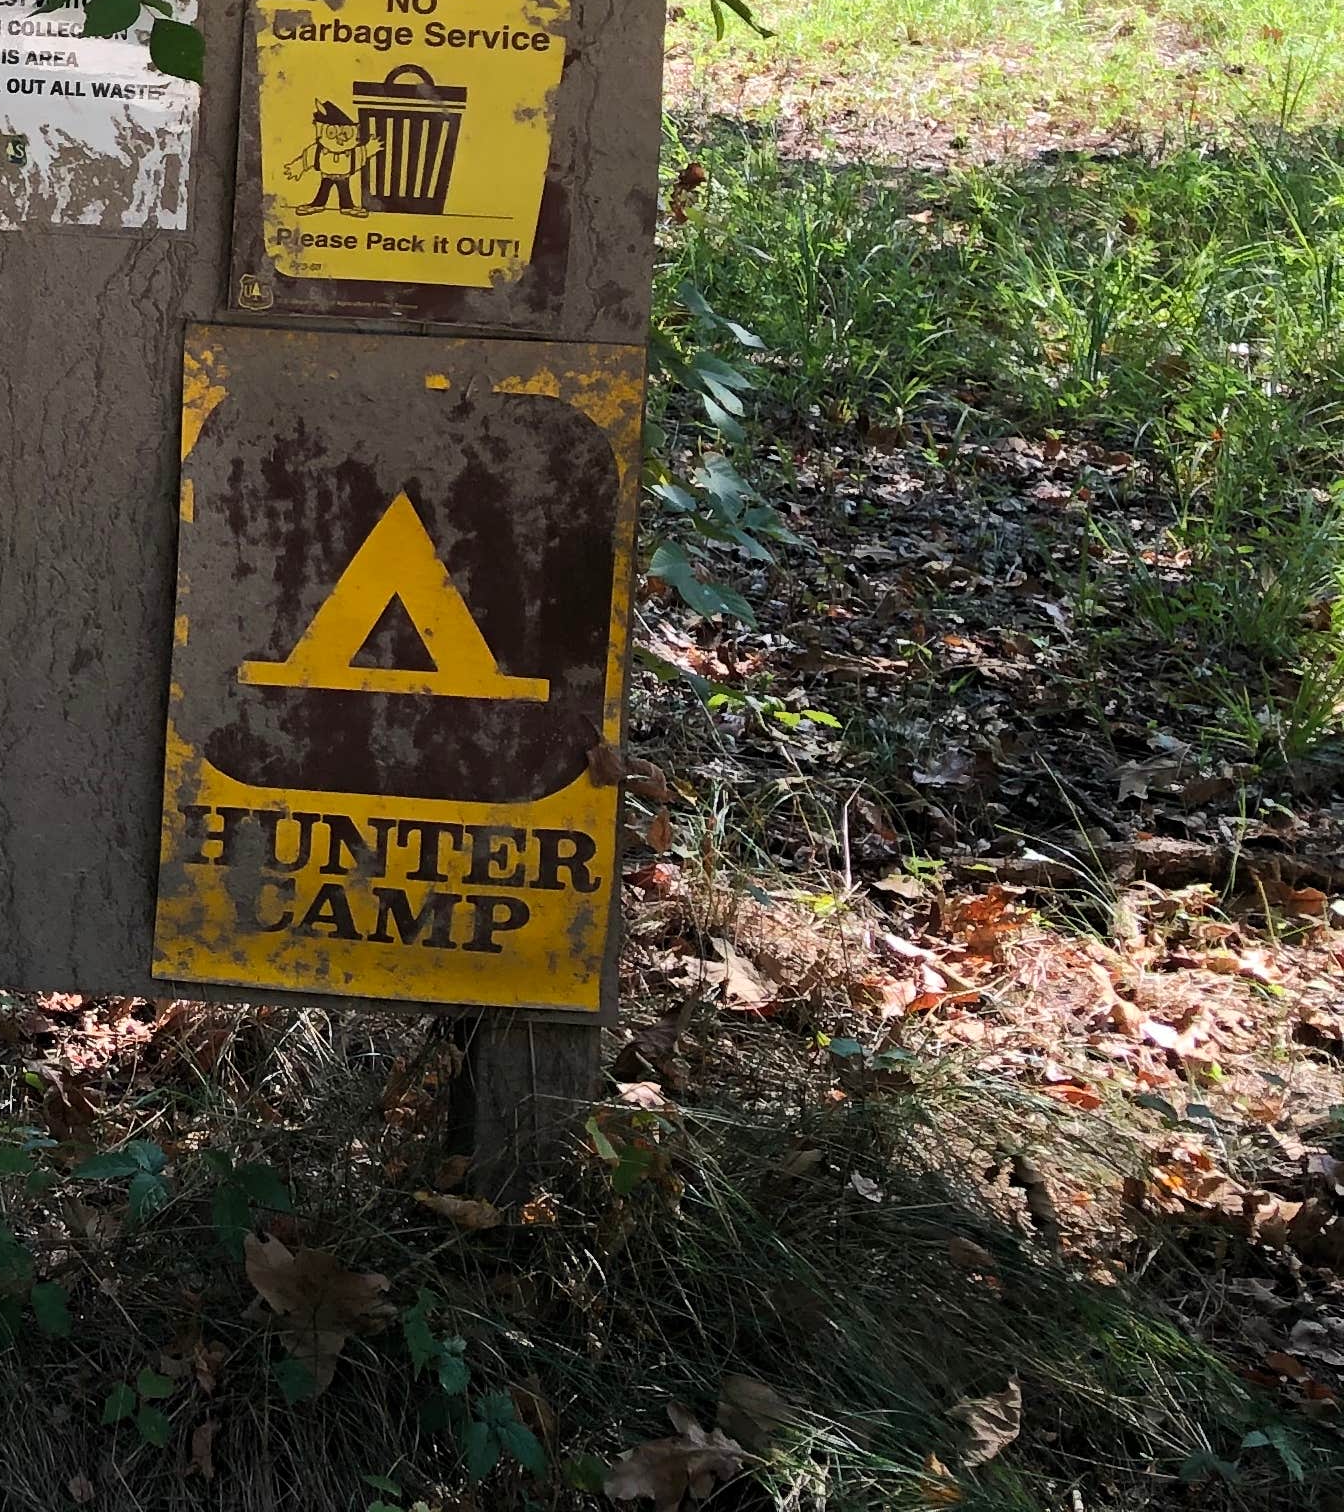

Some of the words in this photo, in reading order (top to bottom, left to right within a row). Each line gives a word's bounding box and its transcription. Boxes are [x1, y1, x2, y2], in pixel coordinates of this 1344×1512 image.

[424, 21, 551, 52] Service
[24, 50, 79, 68] AREA
[6, 77, 46, 95] OUT
[50, 80, 86, 97] ALL
[91, 82, 161, 100] WASTE
[366, 232, 425, 253] Pack
[433, 235, 449, 254] it
[456, 237, 520, 258] OUT!
[177, 803, 601, 893] HUNTER
